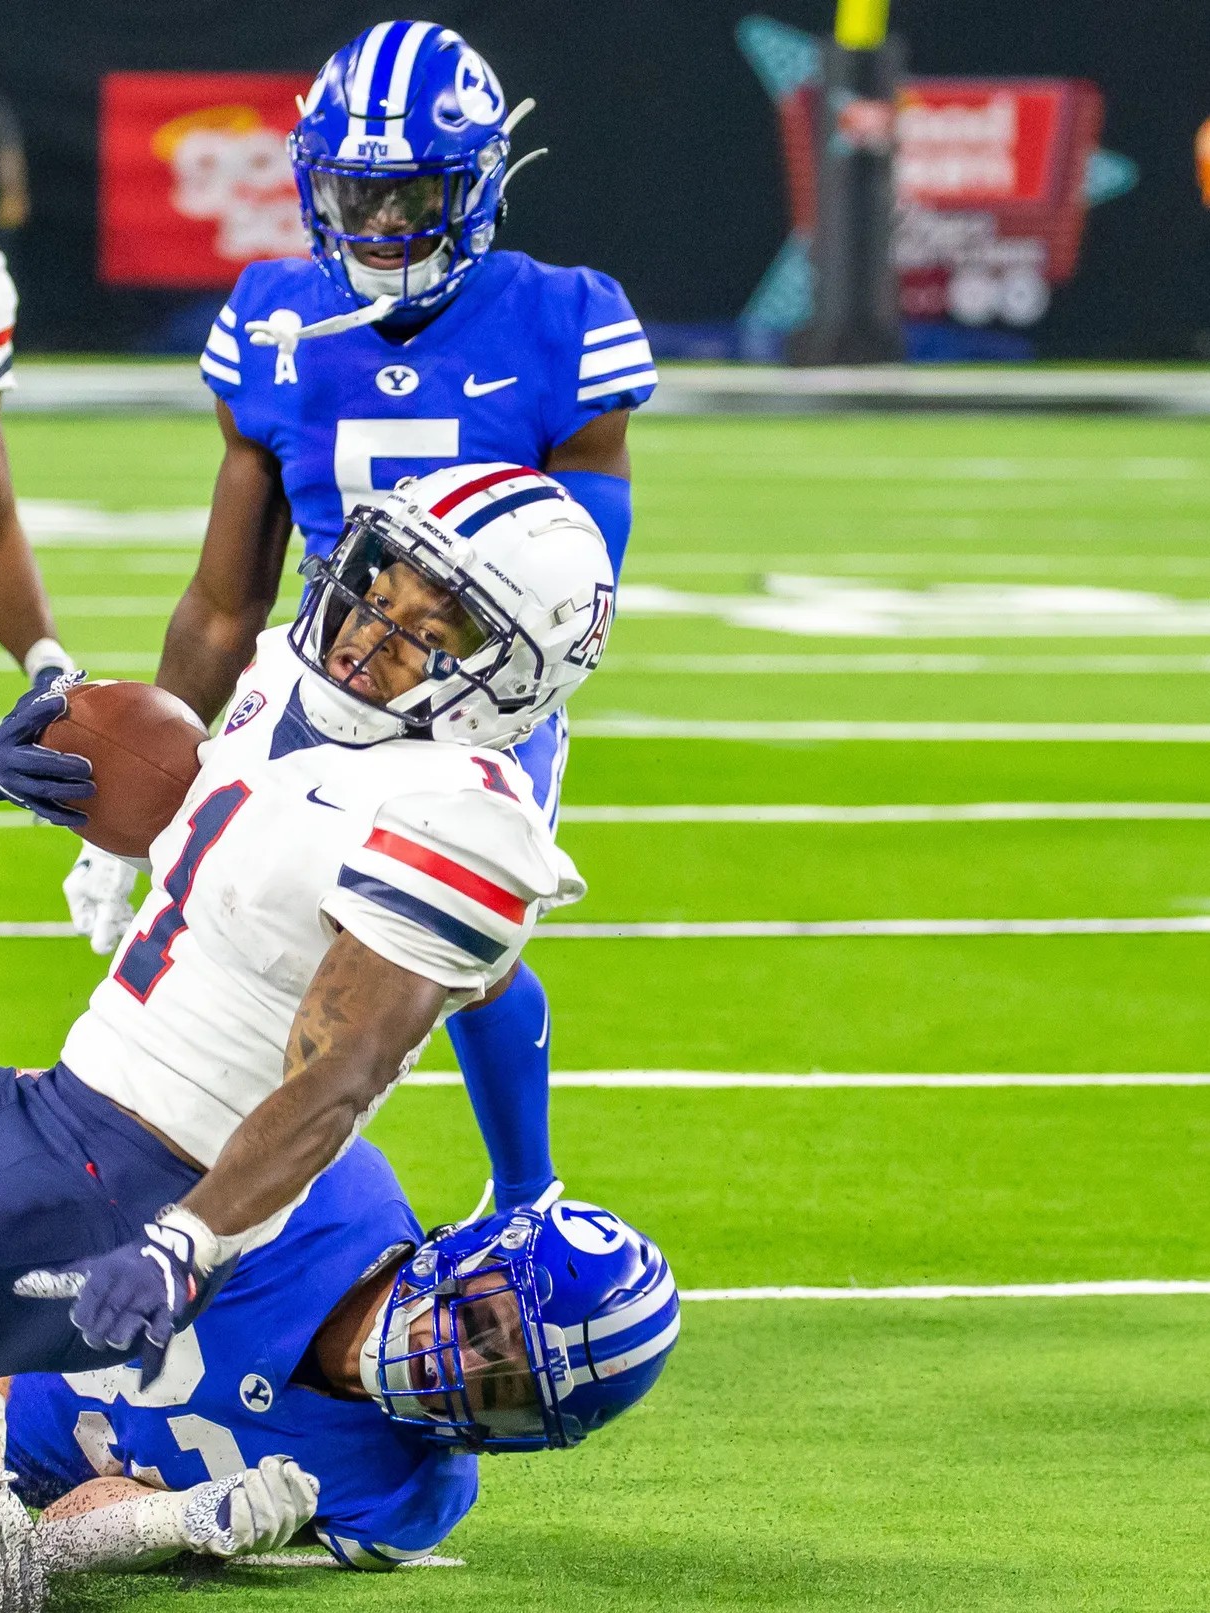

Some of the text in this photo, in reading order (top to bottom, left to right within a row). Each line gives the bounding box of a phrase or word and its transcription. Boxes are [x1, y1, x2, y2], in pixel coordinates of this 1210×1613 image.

[357, 140, 388, 160] BYU
[384, 369, 411, 391] Y
[419, 520, 454, 549] ARIZONA
[562, 581, 614, 671] A
[471, 755, 522, 804] 1
[114, 779, 253, 1006] 1
[561, 1206, 620, 1244] Y
[547, 1345, 568, 1382] BYU
[243, 1378, 270, 1406] Y
